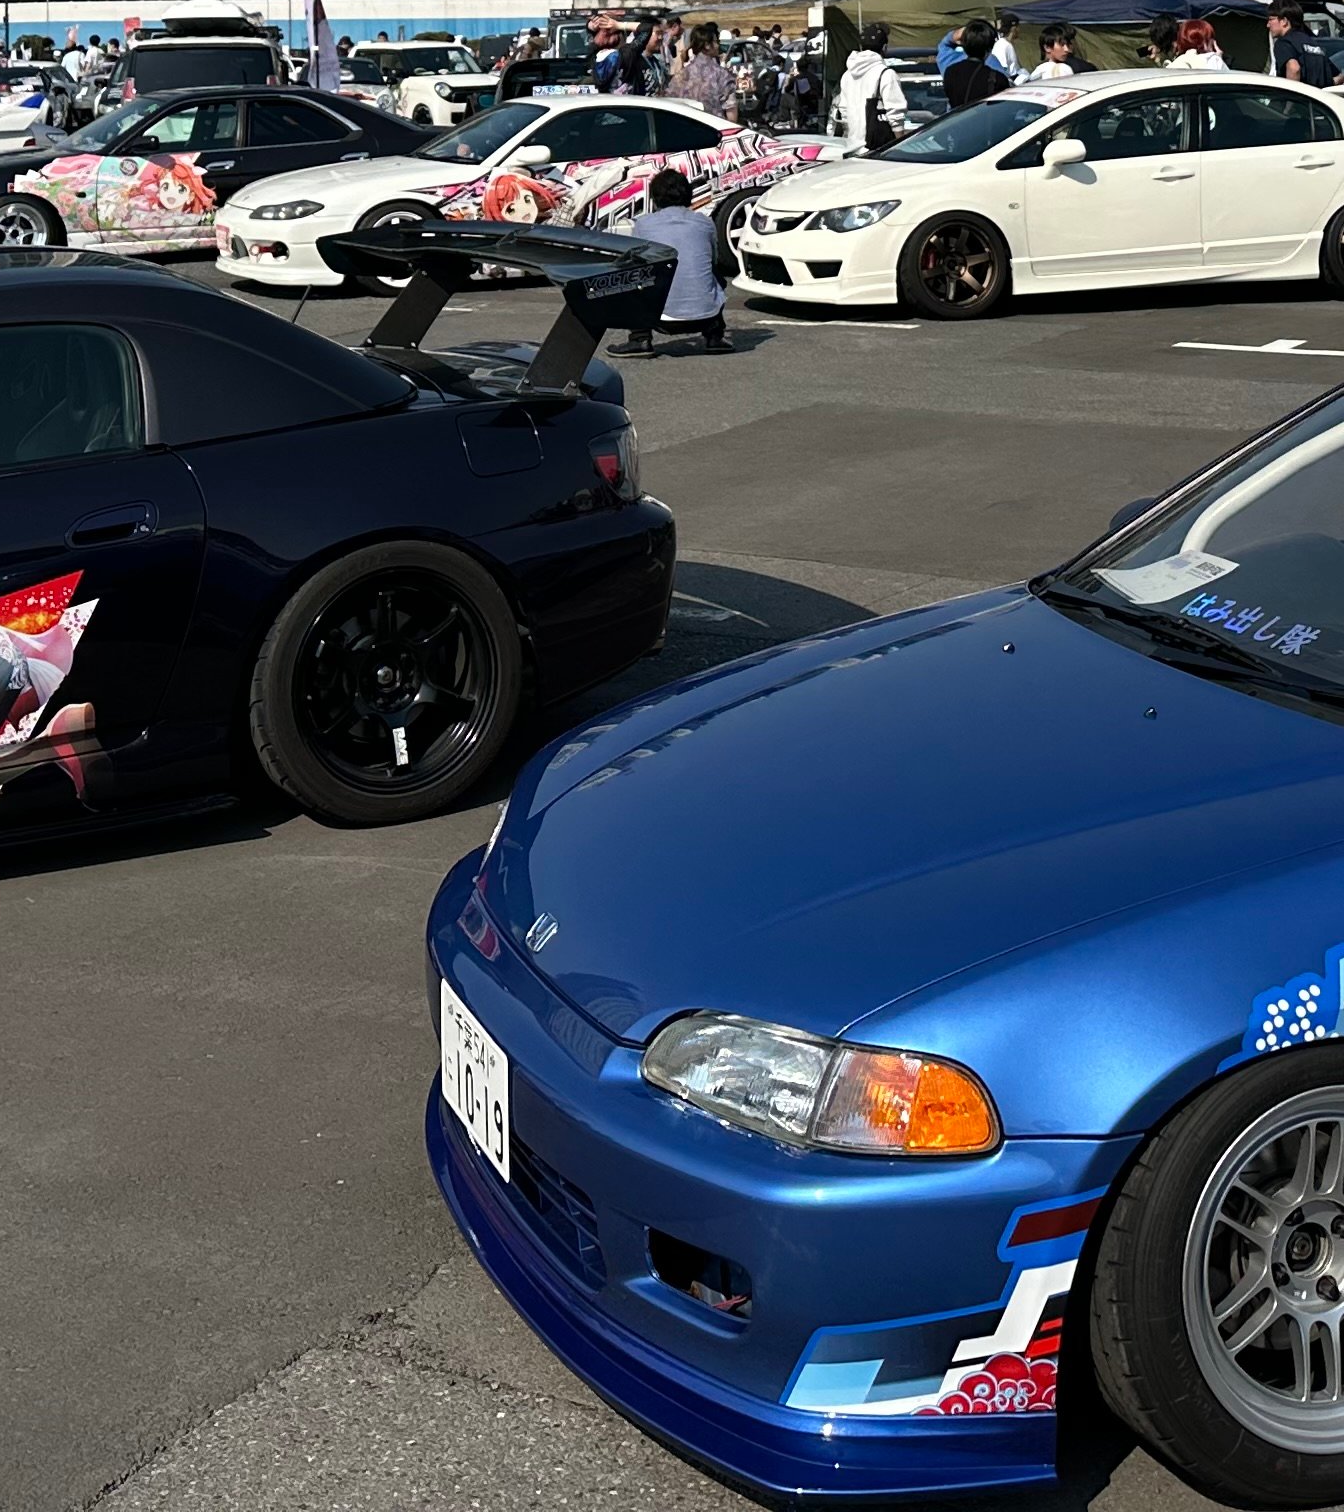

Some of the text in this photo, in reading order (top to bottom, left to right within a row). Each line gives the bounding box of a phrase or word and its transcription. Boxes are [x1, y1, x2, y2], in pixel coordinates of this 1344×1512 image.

[583, 265, 657, 293] VOLTEX
[1180, 592, 1322, 655] はみ出し隊
[457, 1049, 504, 1164] 10-19
